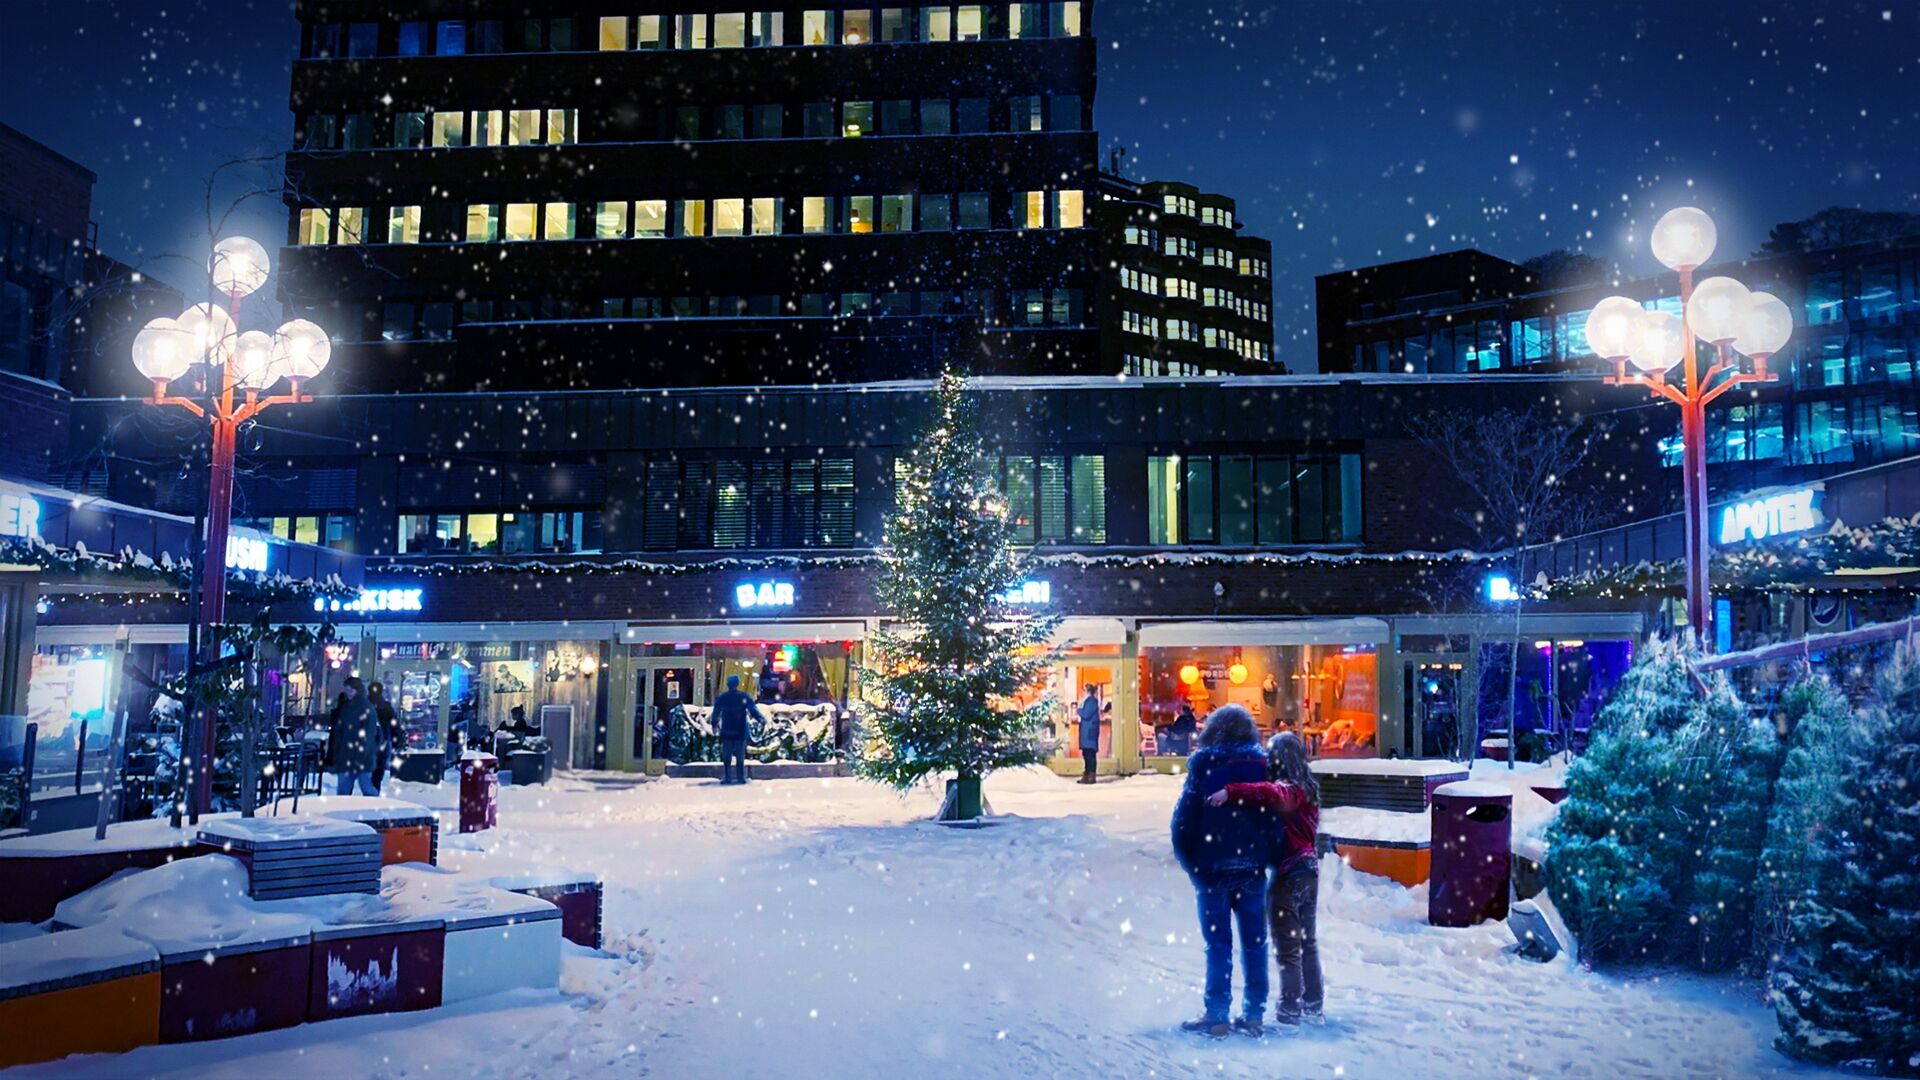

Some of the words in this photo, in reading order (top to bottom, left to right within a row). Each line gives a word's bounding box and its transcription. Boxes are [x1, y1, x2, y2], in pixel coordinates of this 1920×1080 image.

[1721, 489, 1814, 544] APOTEK
[225, 535, 268, 573] USHI
[736, 583, 795, 607] BAR
